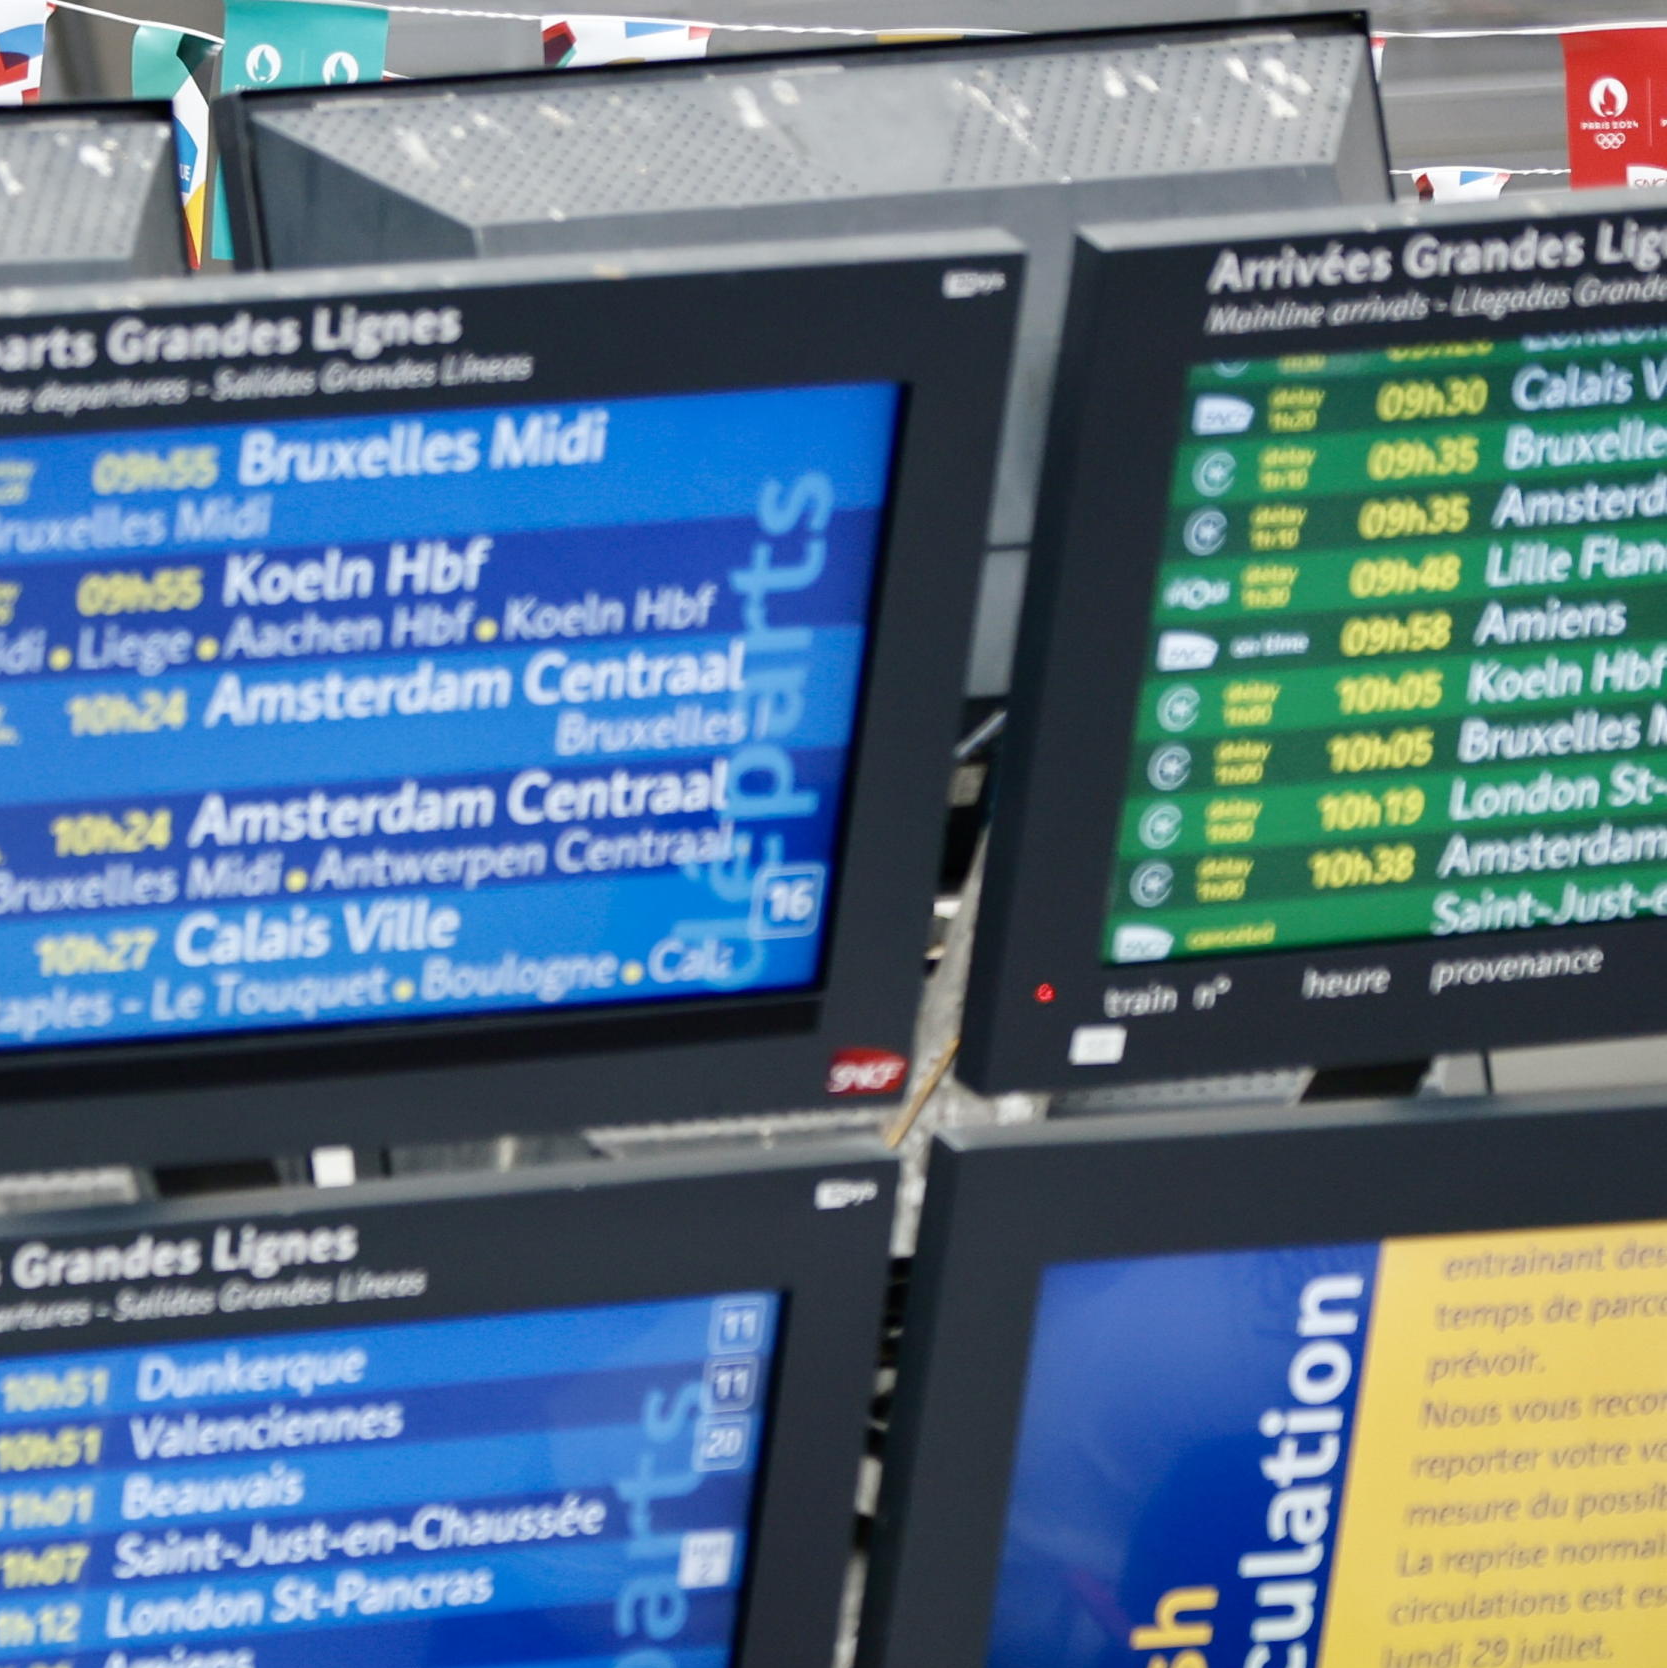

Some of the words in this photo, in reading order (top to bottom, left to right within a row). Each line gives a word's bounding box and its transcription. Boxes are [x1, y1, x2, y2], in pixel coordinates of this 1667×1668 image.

[1580, 120, 1610, 130] PARIS
[1611, 119, 1640, 130] 2024
[1206, 240, 1394, 294] Arrivées
[1403, 227, 1585, 278] Grandes
[106, 311, 301, 363] Grandes
[312, 303, 463, 360] Lignes
[1204, 298, 1325, 335] Mainline
[1328, 288, 1430, 326] arrivals
[1451, 280, 1571, 322] Llegadas
[1271, 386, 1326, 410] delay
[1376, 374, 1489, 421] 09h30
[1512, 359, 1635, 411] Calais
[92, 444, 221, 496] 09h55
[237, 421, 479, 487] Bruxelles
[490, 408, 610, 470] Midi
[1259, 446, 1317, 468] delay
[1367, 433, 1479, 482] 09h35
[173, 493, 274, 544] Midi
[1250, 506, 1309, 528] delay
[1357, 494, 1470, 541] 09h35
[75, 565, 204, 619] 09h55
[222, 547, 375, 608] Koeln
[387, 535, 493, 597] Hbf
[1241, 564, 1299, 587] delay
[1349, 552, 1462, 601] 09h48
[1484, 537, 1573, 588] Lille
[78, 623, 194, 678] Liege
[222, 608, 383, 662] Aachen
[392, 600, 477, 648] Hbf
[502, 593, 624, 644] Koeln
[633, 581, 718, 634] Hbf
[1340, 609, 1452, 657] 09h58
[1473, 595, 1628, 647] Amiens
[66, 687, 189, 737] 10h24
[203, 660, 511, 729] Amsterdam
[522, 641, 747, 706] Centraal
[1223, 680, 1281, 703] delay
[1335, 669, 1444, 715] 10h05
[1467, 654, 1585, 705] Koeln
[1589, 646, 1667, 693] Hbf
[554, 703, 750, 757] Bruxelles
[667, 471, 833, 989] départs
[1214, 739, 1272, 762] delay
[1326, 726, 1435, 774] 10h05
[1457, 707, 1642, 764] Bruxelles
[50, 808, 173, 858] 10h24
[186, 779, 496, 849] Amsterdam
[505, 756, 733, 827] Centraal
[1204, 799, 1263, 822] delay
[1317, 786, 1426, 832] 10h19
[1448, 769, 1601, 821] London
[184, 850, 285, 900] Midi
[312, 845, 548, 892] Antwerpen
[553, 821, 737, 876] Centraal
[1195, 857, 1254, 880] delay
[1308, 844, 1416, 889] 10h38
[770, 881, 815, 921] 16
[34, 928, 159, 978] 10h27
[173, 905, 333, 968] Calais
[343, 895, 462, 954] Ville
[151, 977, 206, 1023] Le
[213, 963, 389, 1021] Touquet
[421, 948, 619, 1003] Boulogne
[1104, 984, 1180, 1018] train
[1301, 965, 1392, 1001] heure
[1428, 946, 1605, 996] provenance
[12, 1236, 202, 1290] Grandes
[212, 1222, 359, 1278] Lignes
[1443, 1245, 1606, 1283] entrainant
[1434, 1300, 1535, 1334] temps
[1543, 1295, 1583, 1324] de
[0, 1366, 111, 1413] 10h51
[136, 1347, 367, 1403] Dunkerque
[1426, 1347, 1547, 1387] prévoir.
[128, 1402, 405, 1461] Valenciennes
[1422, 1400, 1503, 1431] Nous
[1510, 1395, 1583, 1423] vous
[120, 1461, 305, 1521] Beauvais
[705, 1430, 743, 1460] 20
[1410, 1446, 1543, 1485] reporter
[1548, 1441, 1633, 1471] votre
[113, 1493, 607, 1581] Saint-Just-en-Chaussée
[1406, 1497, 1521, 1529] mesure
[1528, 1491, 1569, 1520] du
[1397, 1548, 1435, 1579] La
[1443, 1541, 1549, 1579] reprise
[105, 1588, 265, 1640] London
[271, 1567, 495, 1624] St-Pancras
[1389, 1588, 1571, 1628] circulations
[1578, 1582, 1628, 1614] est
